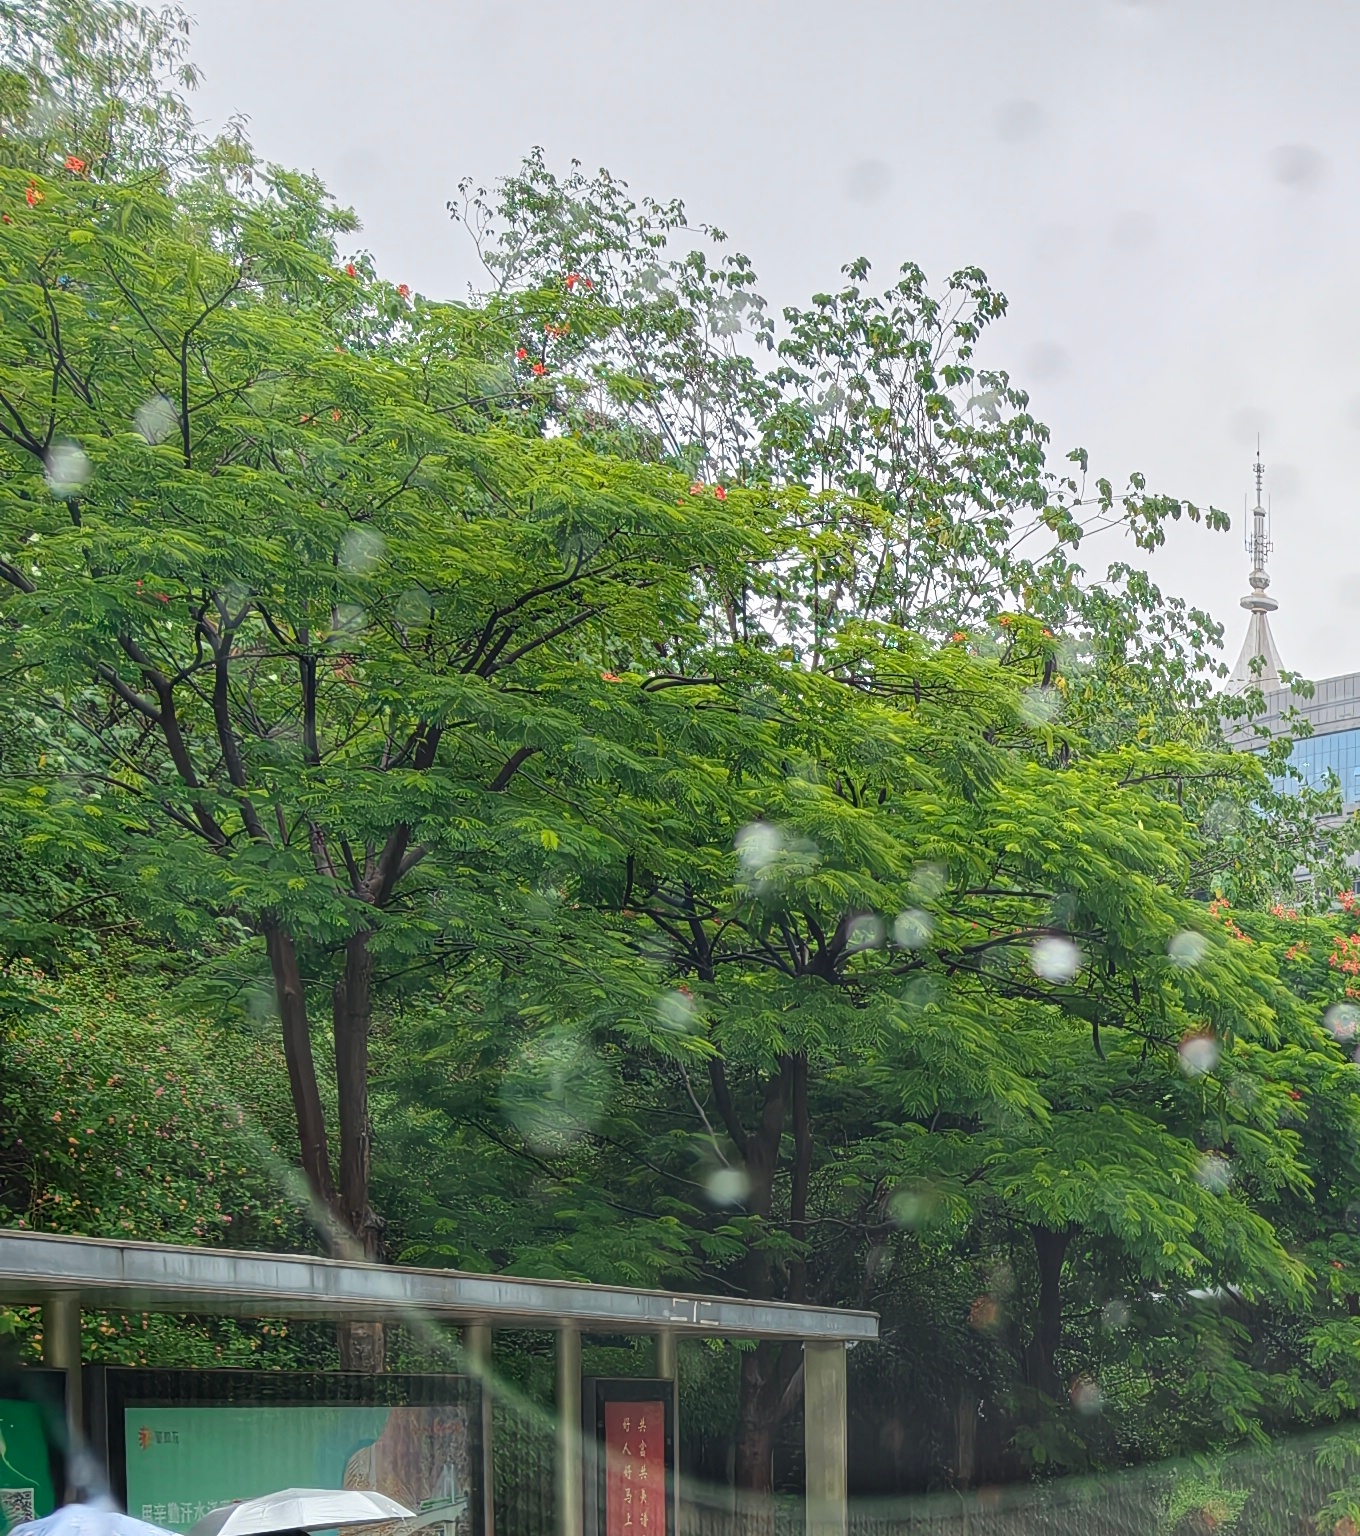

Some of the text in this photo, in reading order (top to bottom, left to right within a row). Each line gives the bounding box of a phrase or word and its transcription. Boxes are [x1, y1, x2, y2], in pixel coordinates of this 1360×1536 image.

[142, 1500, 240, 1525] 用辛勤汗水
